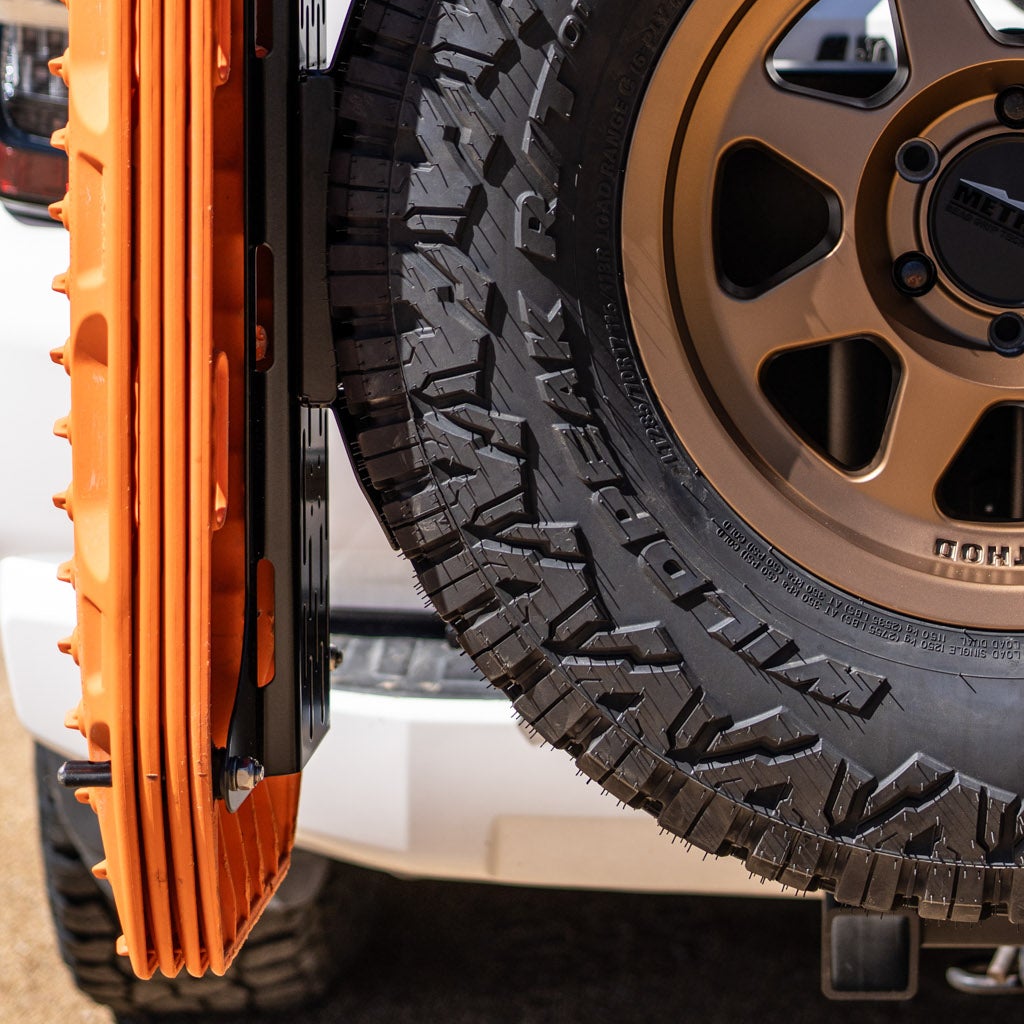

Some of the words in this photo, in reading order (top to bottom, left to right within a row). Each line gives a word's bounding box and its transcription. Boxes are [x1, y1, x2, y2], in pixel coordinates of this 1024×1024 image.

[517, 290, 891, 719] WILDPEAK
[719, 517, 748, 546] COLD
[713, 525, 742, 553] COLD
[802, 582, 828, 602] 350
[798, 591, 823, 610] 350
[826, 595, 843, 610] AT
[822, 604, 839, 618] AT
[919, 639, 945, 653] 1250
[958, 637, 988, 649] DUAL
[991, 640, 1021, 650] LOAD
[948, 645, 987, 659] SINGLE
[991, 650, 1021, 660] LOAD
